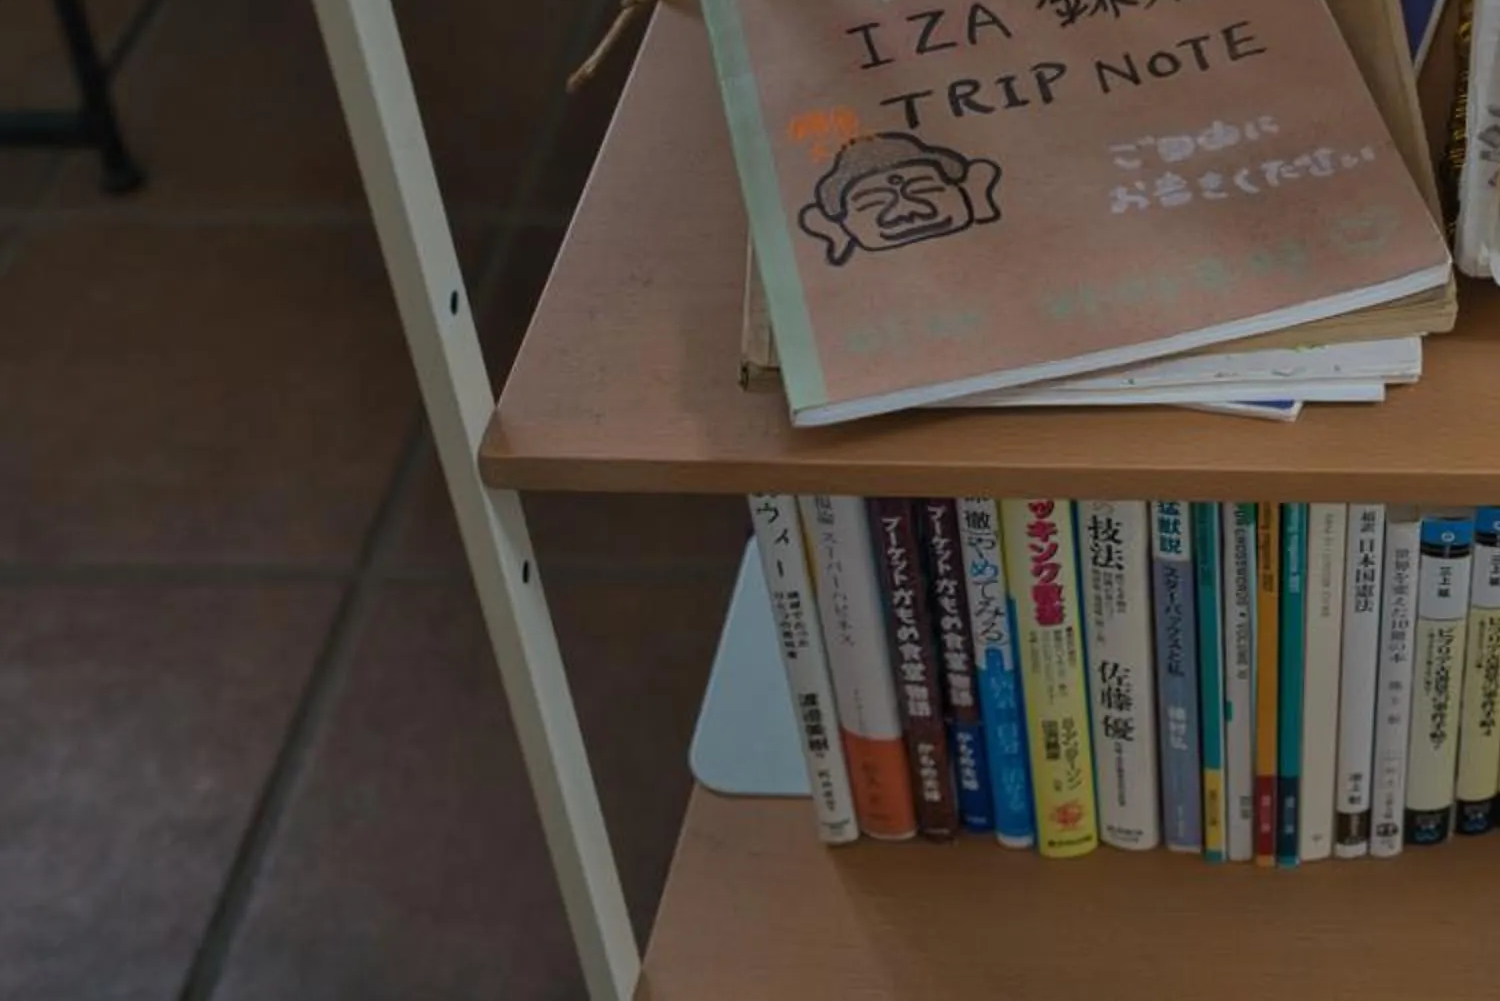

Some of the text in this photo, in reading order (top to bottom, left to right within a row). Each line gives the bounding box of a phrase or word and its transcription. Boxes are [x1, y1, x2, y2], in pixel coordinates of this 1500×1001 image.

[846, 2, 1013, 70] IZA
[879, 61, 1067, 129] TRIP
[754, 493, 789, 578] ウィー
